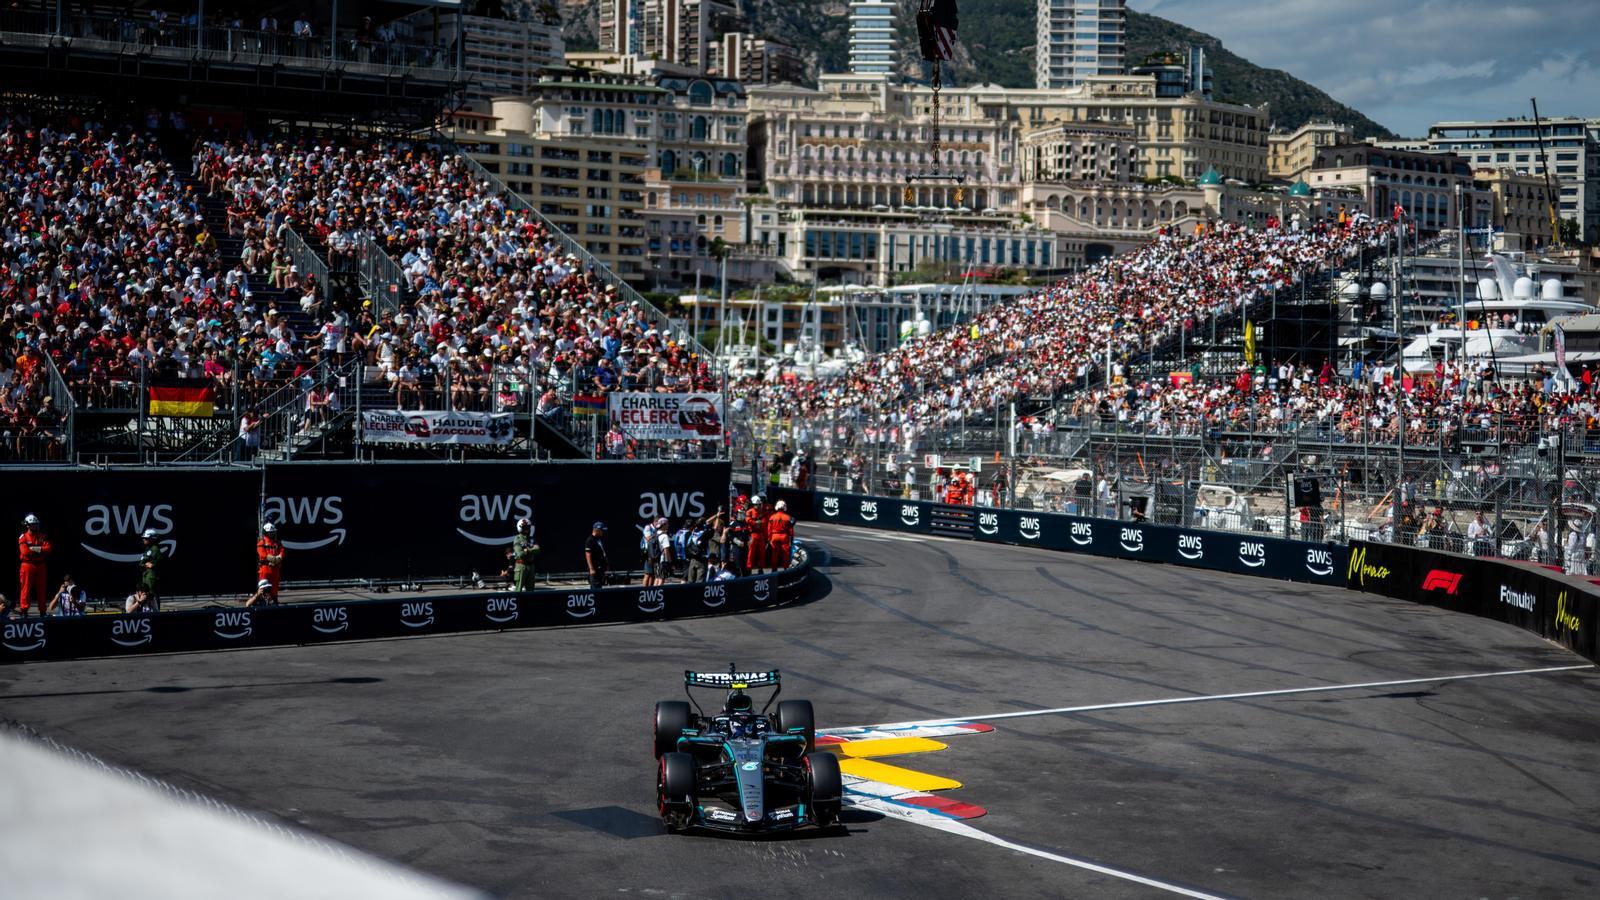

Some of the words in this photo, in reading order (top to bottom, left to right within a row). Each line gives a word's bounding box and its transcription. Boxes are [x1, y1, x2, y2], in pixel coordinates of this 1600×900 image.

[621, 397, 680, 410] CHARLES
[369, 414, 406, 424] CHARLES
[457, 419, 484, 429] DUE
[611, 410, 679, 425] LECLERC
[365, 421, 404, 432] LECLERC
[460, 494, 533, 523] aws
[639, 491, 706, 518] aws
[823, 496, 839, 509] aws
[861, 500, 878, 513] aws
[264, 496, 344, 525] aws
[901, 504, 919, 518] aws
[85, 504, 174, 536] aws
[979, 512, 998, 526] aws
[1020, 516, 1040, 531] aws
[1071, 521, 1092, 536] aws
[1121, 527, 1143, 542] aws
[1178, 534, 1202, 550] aws
[1239, 541, 1265, 557] aws
[1307, 549, 1333, 564] aws
[1348, 546, 1391, 586] Monaco
[753, 578, 770, 592] aws
[1422, 569, 1463, 595] F1
[638, 589, 664, 603] aws
[704, 584, 726, 598] aws
[487, 597, 518, 612] aws
[568, 593, 595, 608] aws
[313, 606, 348, 622] aws
[402, 601, 434, 617] aws
[112, 618, 151, 635] aws
[215, 611, 251, 627] aws
[4, 622, 45, 639] aws
[696, 672, 768, 684] PETRONAS
